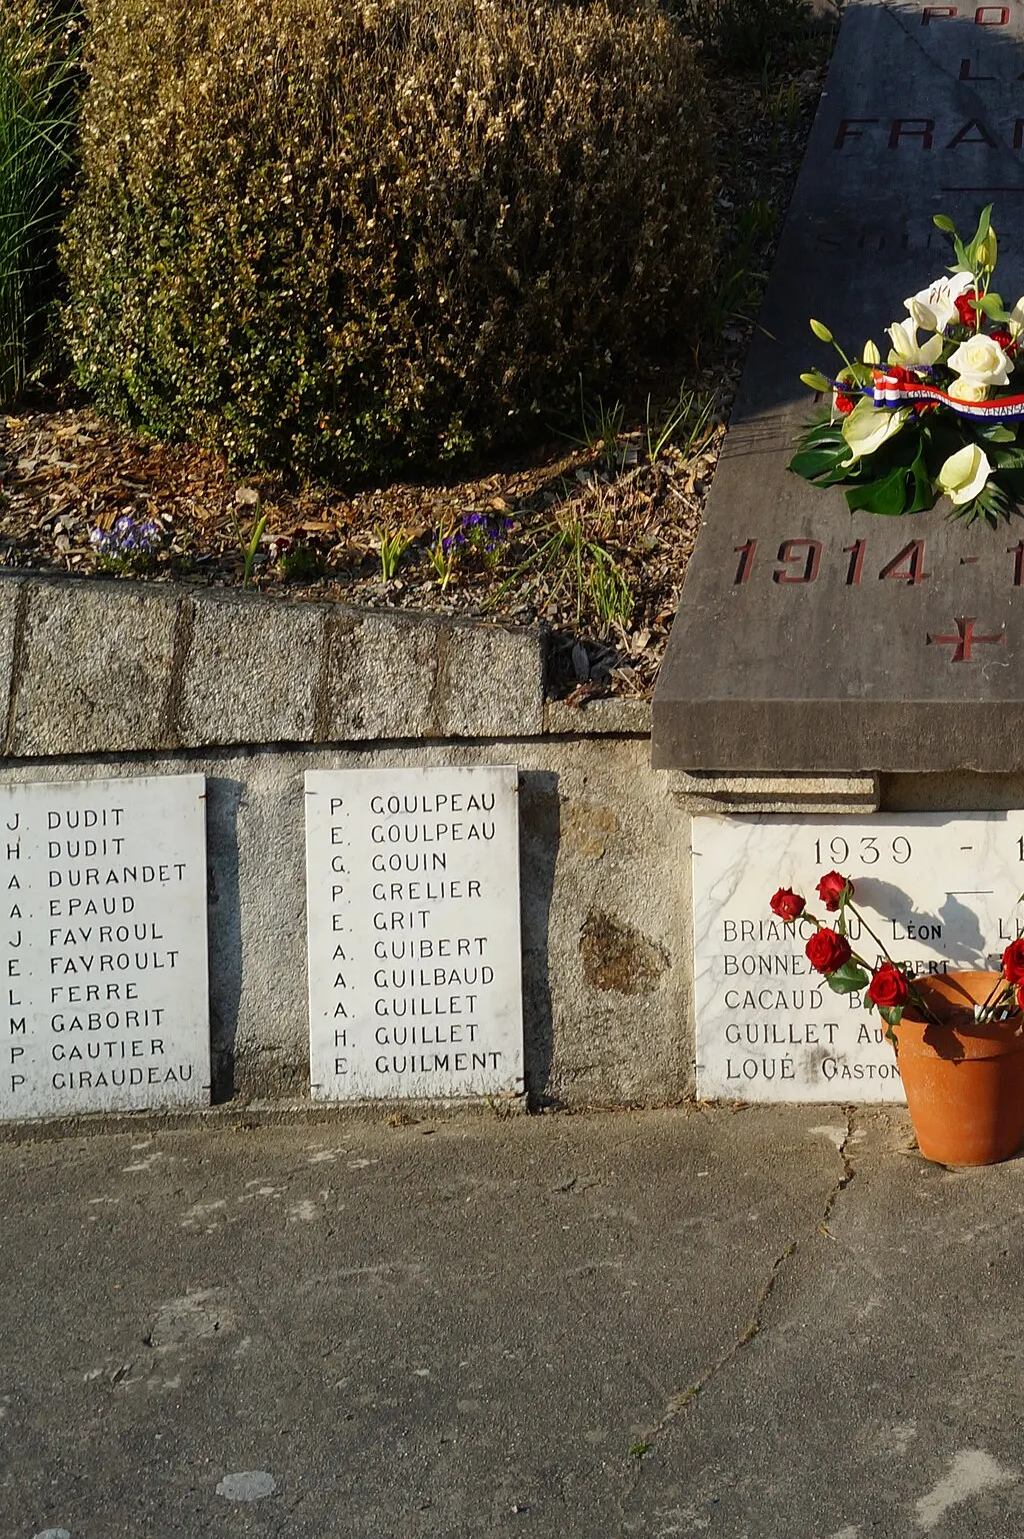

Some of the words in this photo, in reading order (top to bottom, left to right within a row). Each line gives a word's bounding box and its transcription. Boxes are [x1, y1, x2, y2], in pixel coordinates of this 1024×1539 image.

[733, 537, 932, 586] 1914
[330, 797, 352, 817] P.
[370, 792, 496, 817] GOULPEAU
[6, 812, 33, 832] J.
[47, 808, 125, 831] DUDIT
[330, 826, 352, 847] E.
[371, 821, 496, 844] GOULPEAU
[6, 843, 33, 861] H.
[47, 837, 126, 859] DUDIT
[814, 835, 913, 865] 1939
[331, 855, 353, 875] G.
[371, 851, 447, 873] GOUIN
[7, 873, 34, 890] A.
[48, 863, 187, 888] DURANDET
[331, 884, 353, 903] P.
[372, 880, 482, 903] GRELIER
[9, 903, 36, 920] A.
[48, 895, 135, 918] EPAUD
[332, 913, 354, 933] E.
[373, 909, 431, 932] GRIT
[8, 930, 35, 949] J.
[49, 922, 164, 947] FAVROUL
[331, 943, 354, 962] A.
[373, 936, 488, 960] GUIBERT
[7, 958, 34, 978] E.
[49, 950, 180, 975] FAVROULT
[333, 972, 355, 990] A.
[373, 965, 494, 989] GUILBAUD
[8, 988, 35, 1007] L.
[50, 982, 139, 1004] FERRE
[333, 1001, 356, 1019] A.
[374, 994, 478, 1018] GUILLET
[724, 989, 823, 1010] CACAUD
[9, 1016, 36, 1036] M.
[50, 1008, 165, 1034] GABORIT
[725, 1023, 839, 1044] GUILLET
[334, 1028, 356, 1048] H.
[374, 1023, 479, 1047] GUILLET
[10, 1046, 37, 1065] P.
[51, 1038, 165, 1062] GAUTIER
[334, 1057, 357, 1077] E.
[374, 1051, 503, 1075] GUILMENT
[10, 1074, 37, 1093] P.
[51, 1064, 193, 1091] GIRAUDEAU
[726, 1052, 795, 1080] LOUÉ
